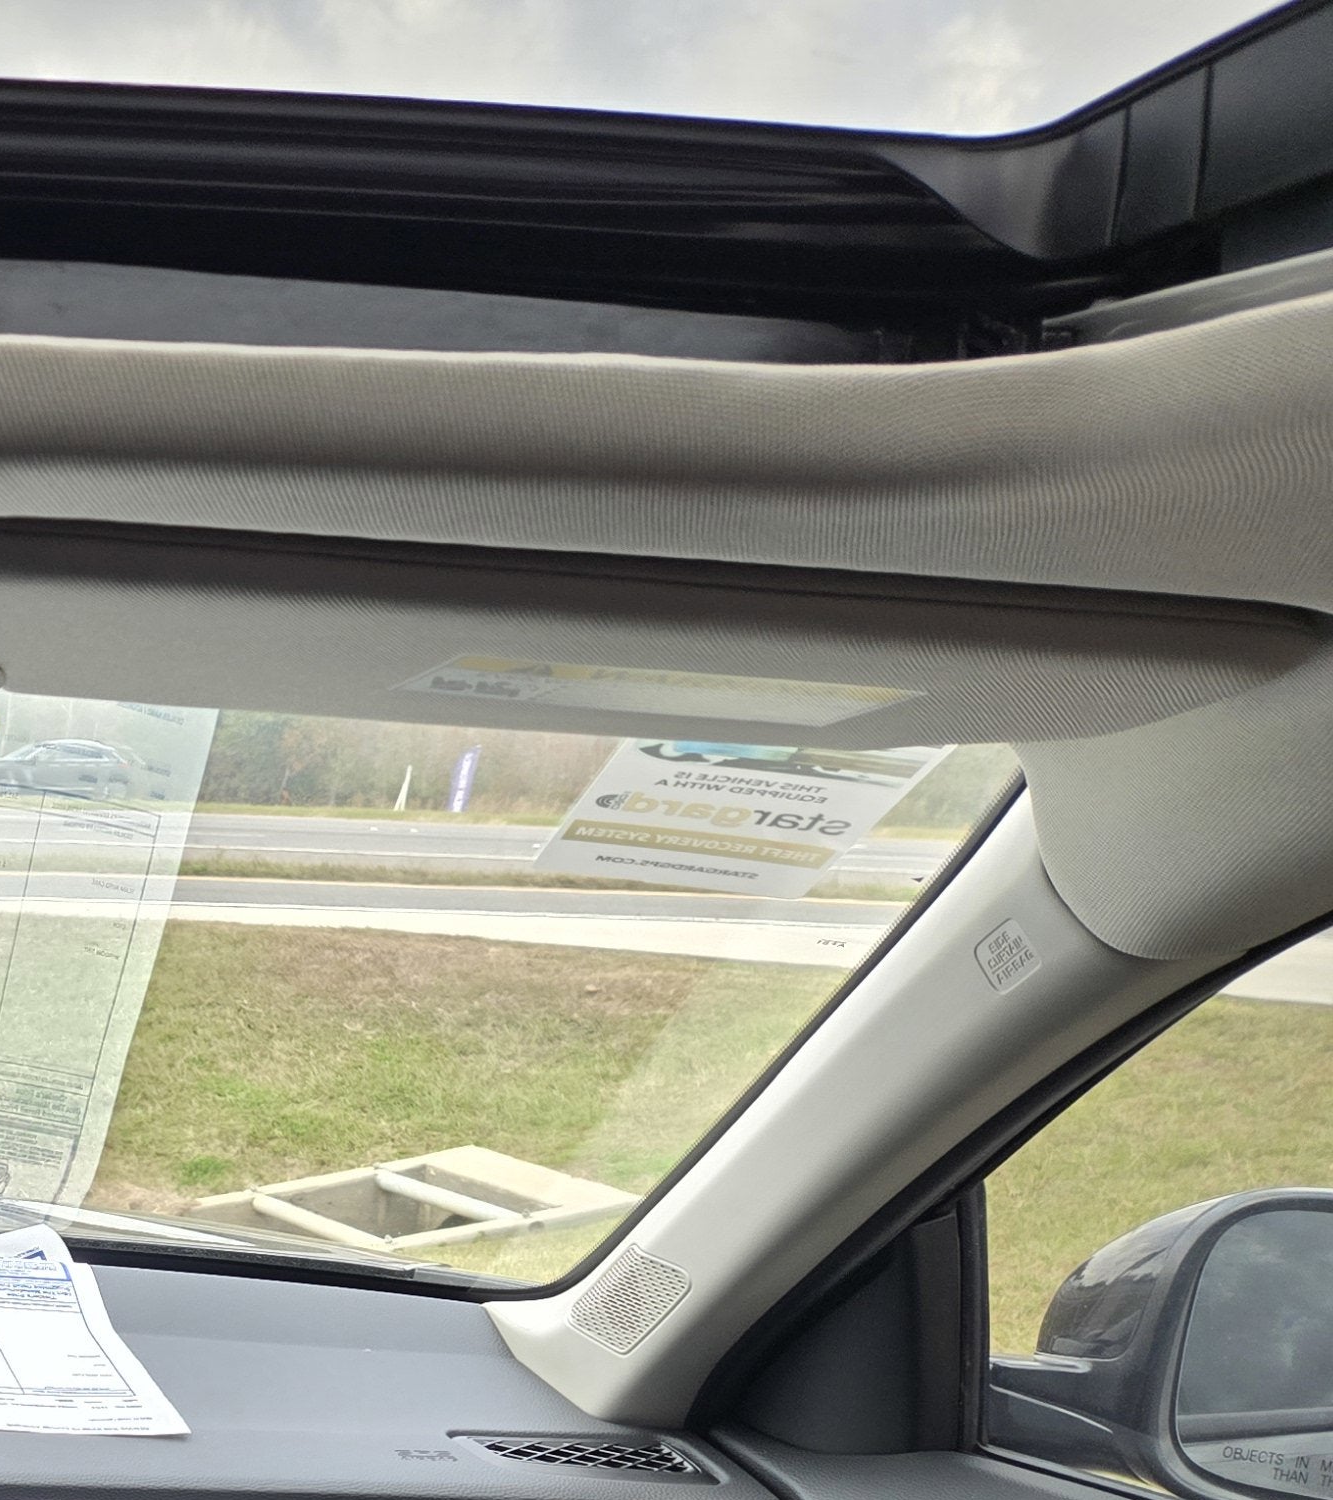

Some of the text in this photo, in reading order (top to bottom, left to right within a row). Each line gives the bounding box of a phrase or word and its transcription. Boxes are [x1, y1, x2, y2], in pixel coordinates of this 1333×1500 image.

[988, 930, 1011, 954] SIDE
[1223, 1446, 1285, 1465] OBJECTS
[1294, 1456, 1310, 1469] IN
[1273, 1467, 1309, 1484] THAN
